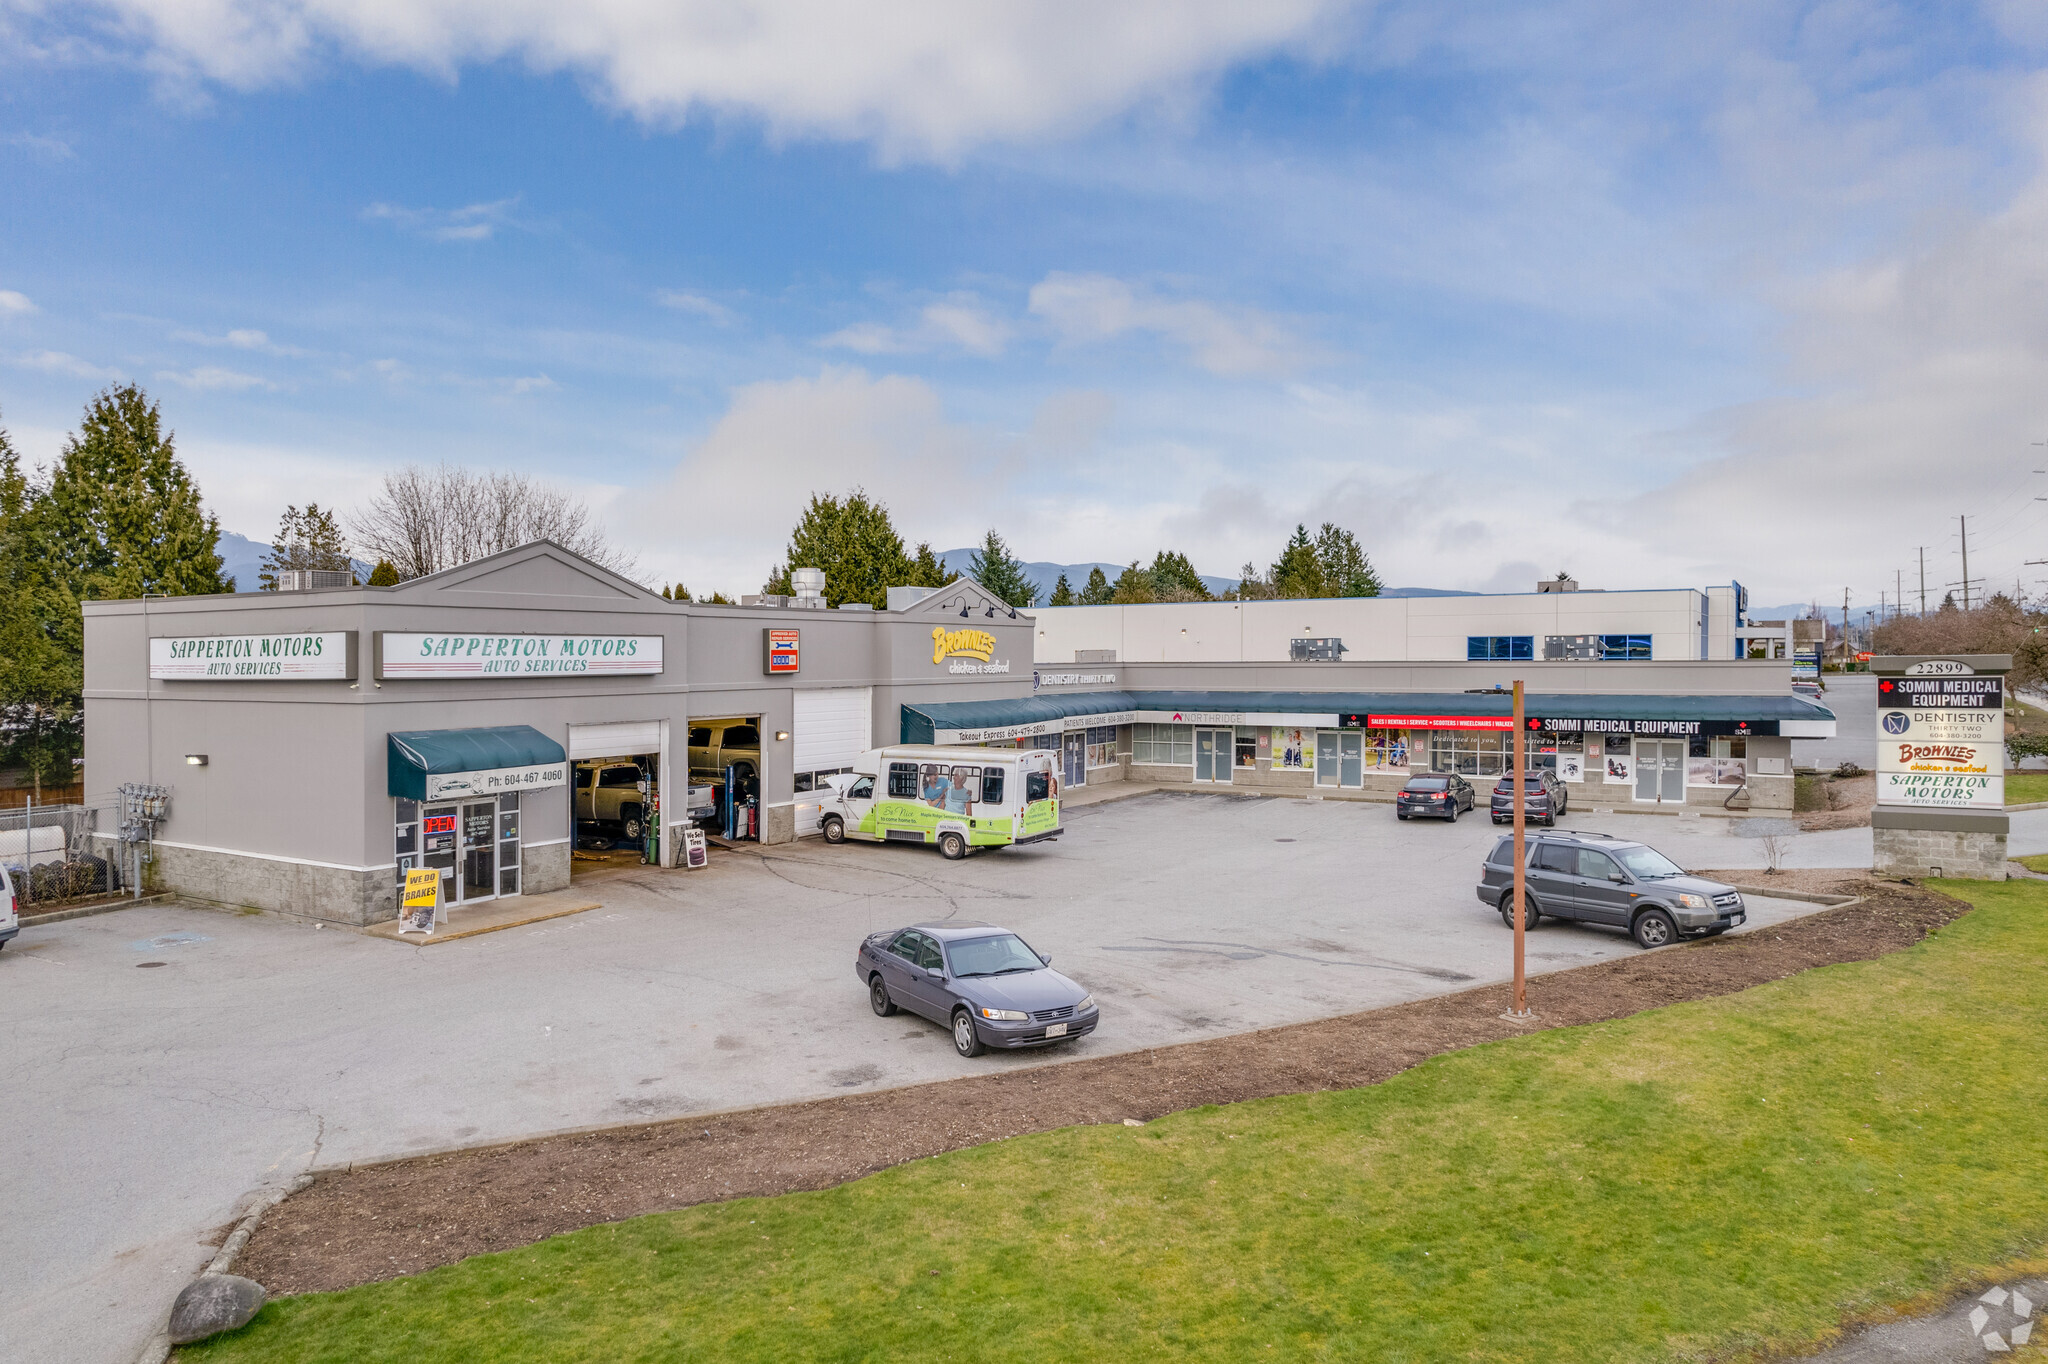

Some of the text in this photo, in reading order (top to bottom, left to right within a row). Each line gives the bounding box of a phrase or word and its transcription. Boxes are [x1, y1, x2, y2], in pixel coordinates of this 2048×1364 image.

[170, 637, 323, 658] SAPPERTON MOTORS
[420, 637, 637, 657] SAPPERTON MOTORS
[932, 627, 996, 664] BROWNIES
[207, 662, 281, 675] AUTO SERVICES
[484, 660, 587, 672] AUTO SERVICES
[949, 660, 976, 674] chicken
[984, 660, 1009, 673] seafood
[1917, 663, 1963, 674] 22899
[1041, 674, 1079, 684] DENTISTRY
[1898, 681, 2000, 693] SOMMI MEDICAL
[1912, 695, 1985, 706] EQUIPMENT
[1064, 718, 1084, 728] PATIENTS
[1085, 716, 1106, 726] WELCOME
[1184, 714, 1242, 723] NORTHRIDGE
[1914, 713, 1996, 723] DENTISTRY
[959, 725, 1045, 741] Takeout Express 604-479-2800
[1545, 719, 1700, 734] SOMMI MEDICAL EQUIPMENT
[1899, 744, 1976, 763] BROWNIES
[1910, 762, 1943, 772] chicken
[1953, 764, 1987, 773] seafood
[489, 776, 502, 787] Ph:
[1890, 775, 1990, 788] SAPPERTON
[1904, 787, 1975, 800] MOTORS
[423, 816, 456, 833] OPEN
[410, 876, 422, 884] WE
[424, 873, 435, 881] DO
[405, 886, 436, 901] BRAKES
